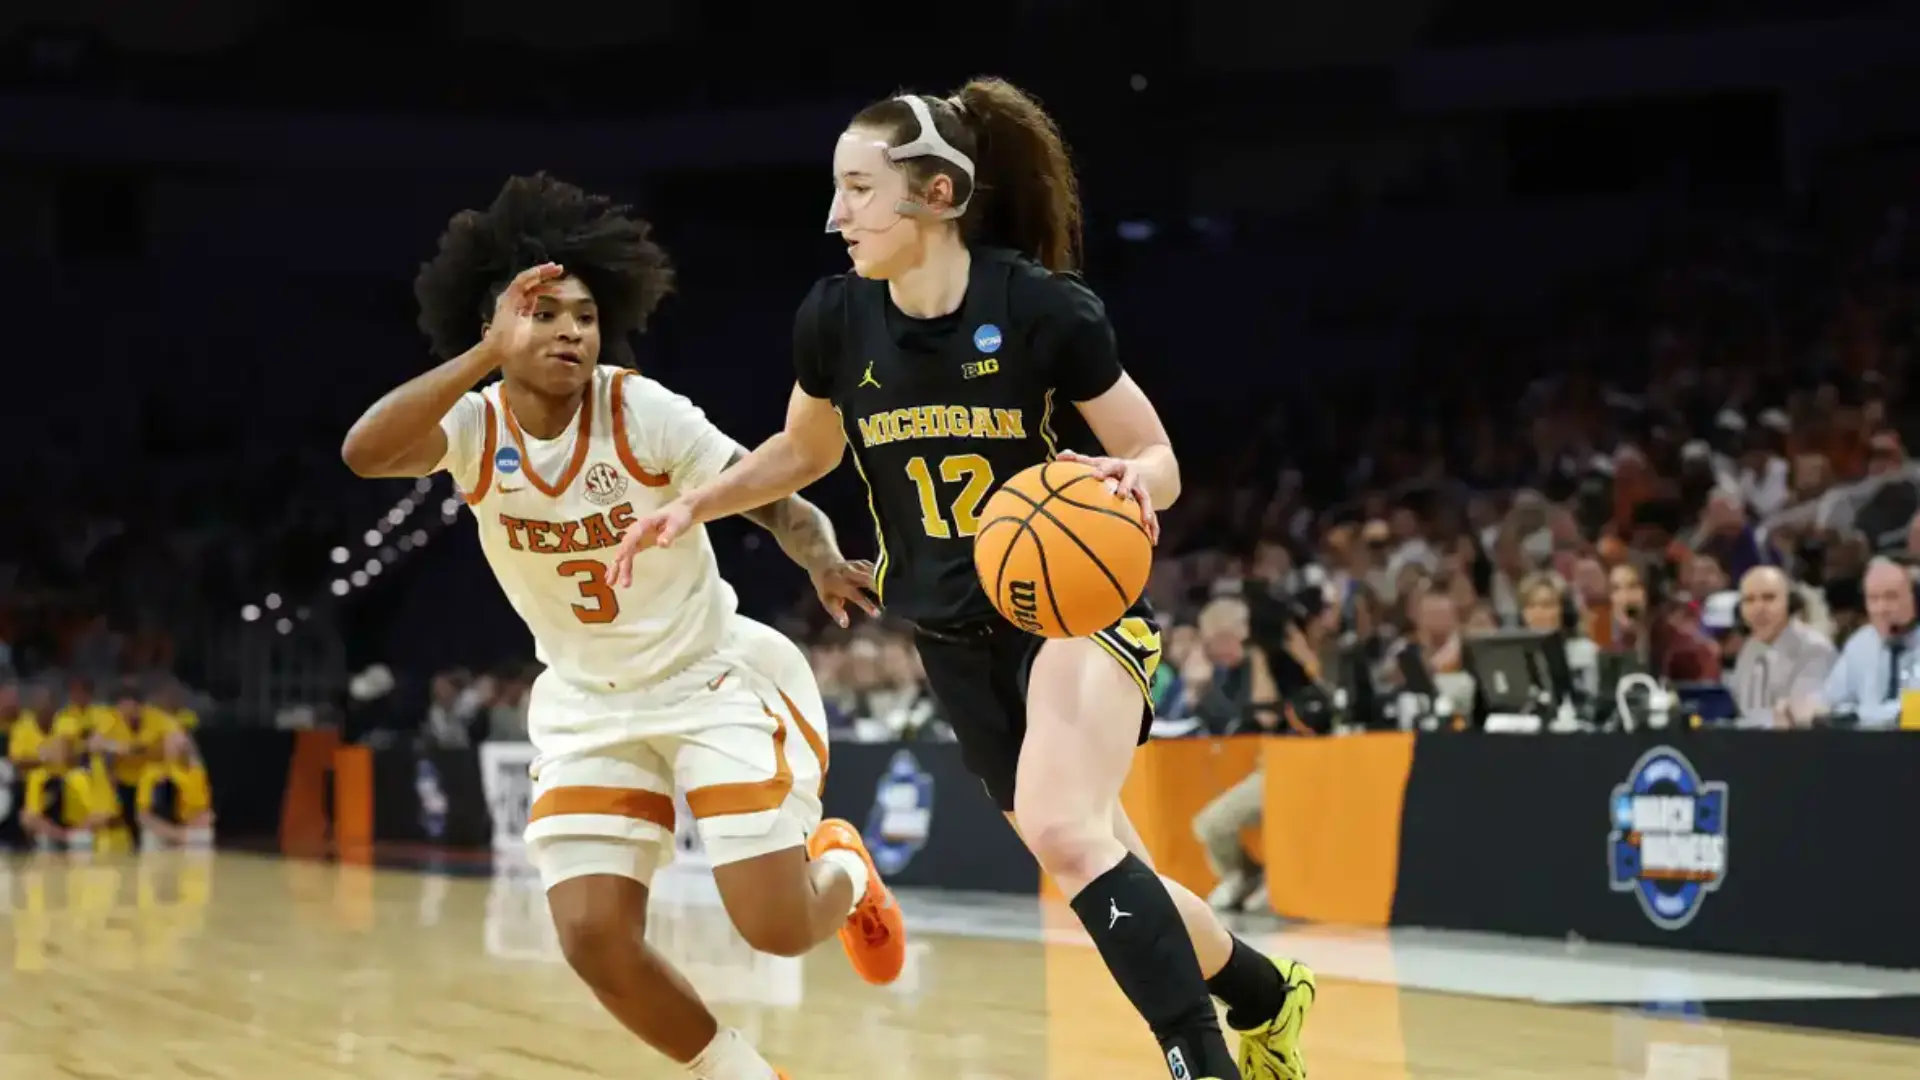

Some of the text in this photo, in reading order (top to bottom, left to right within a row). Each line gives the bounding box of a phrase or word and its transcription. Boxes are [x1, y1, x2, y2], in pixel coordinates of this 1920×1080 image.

[858, 405, 1027, 448] MICHIGAN
[905, 454, 995, 539] 12
[499, 501, 638, 554] TEXAS
[556, 559, 619, 624] 3
